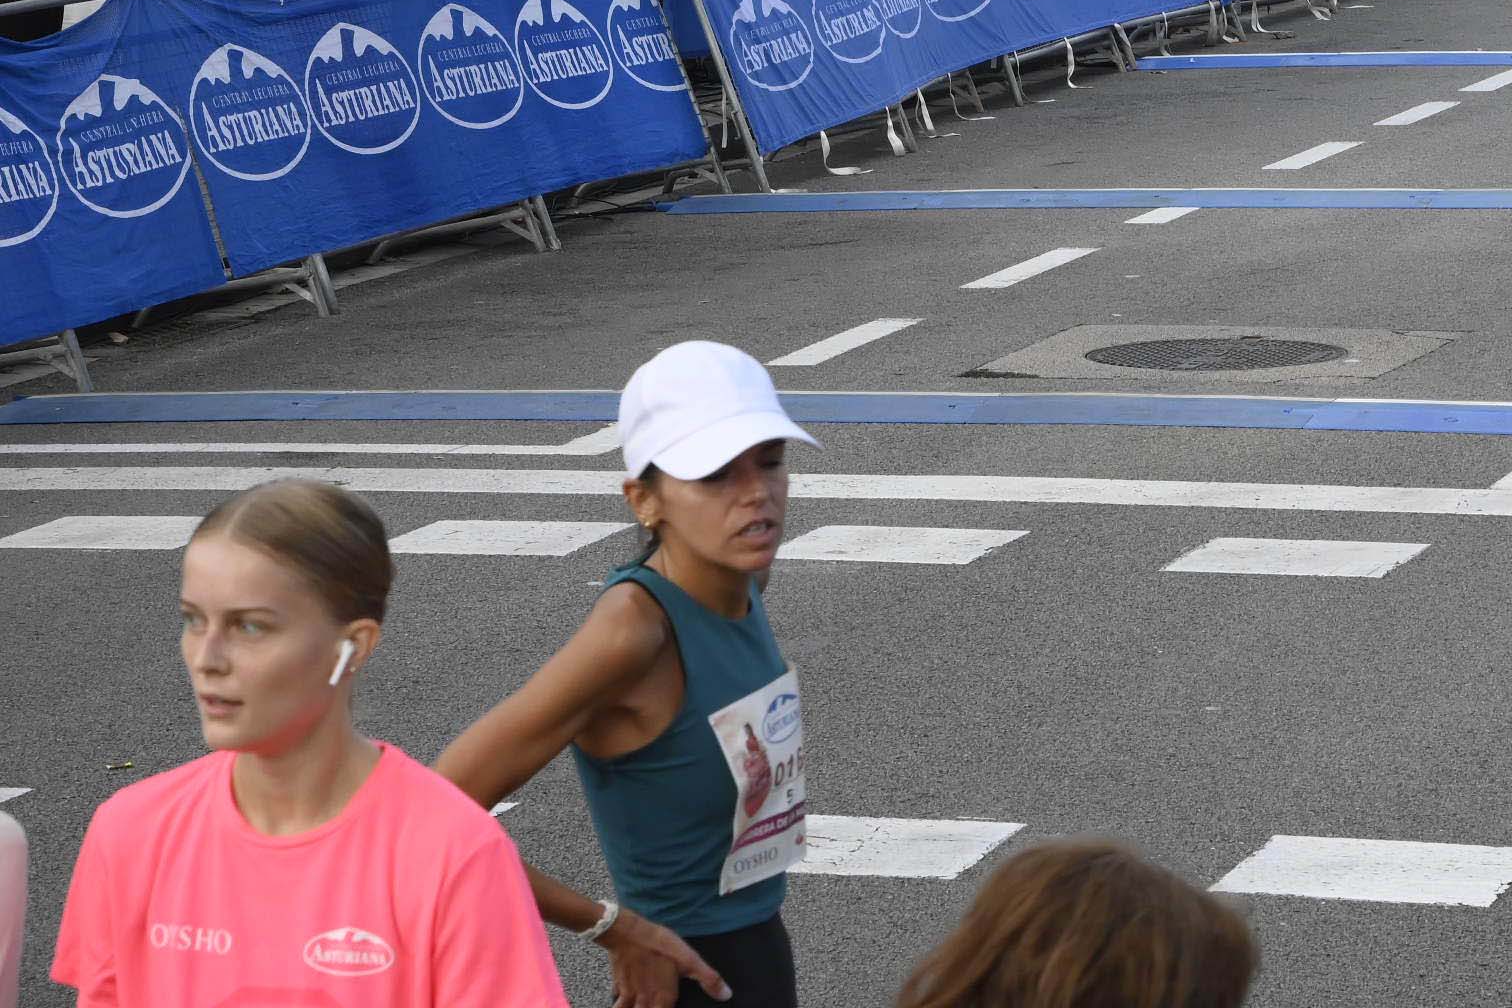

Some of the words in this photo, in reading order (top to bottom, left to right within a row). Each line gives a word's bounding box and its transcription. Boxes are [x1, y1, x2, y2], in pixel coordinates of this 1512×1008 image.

[523, 39, 608, 85] ASTURIANA
[616, 23, 677, 66] ASTUR
[427, 54, 519, 103] ASTURIANA
[315, 77, 415, 129] ASTURIANA
[201, 100, 305, 154] ASTURIANA
[69, 129, 182, 190] ASTURIANA
[734, 846, 778, 874] OYSHO
[150, 923, 233, 955] OYSHO
